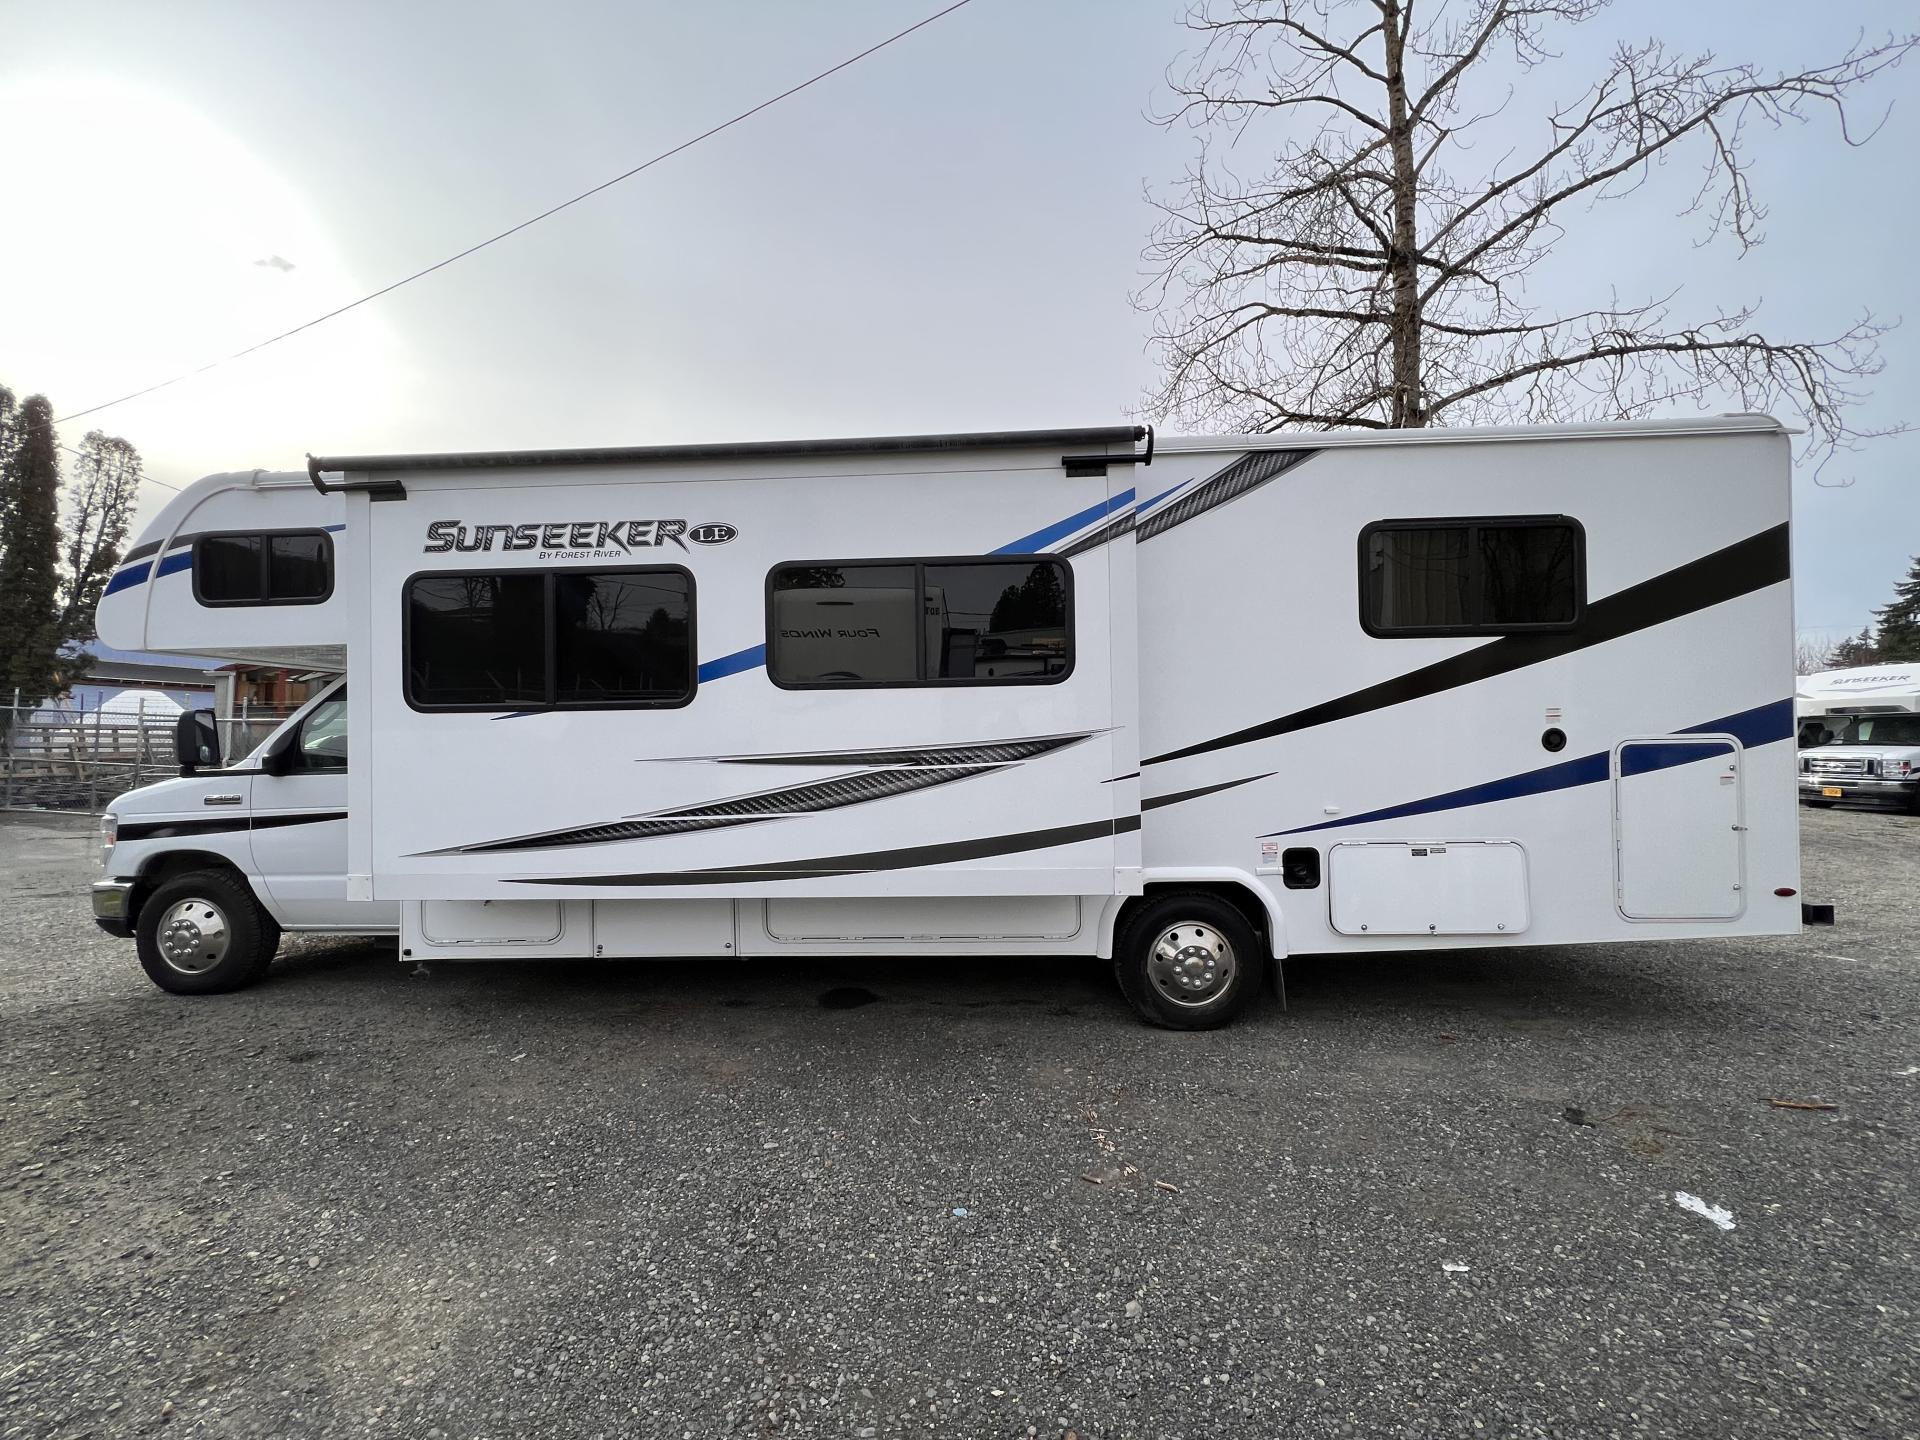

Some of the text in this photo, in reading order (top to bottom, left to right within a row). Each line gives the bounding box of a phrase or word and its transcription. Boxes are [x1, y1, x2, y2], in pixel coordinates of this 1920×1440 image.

[698, 526, 729, 541] LE
[539, 549, 621, 559] BY FOREST RIVER
